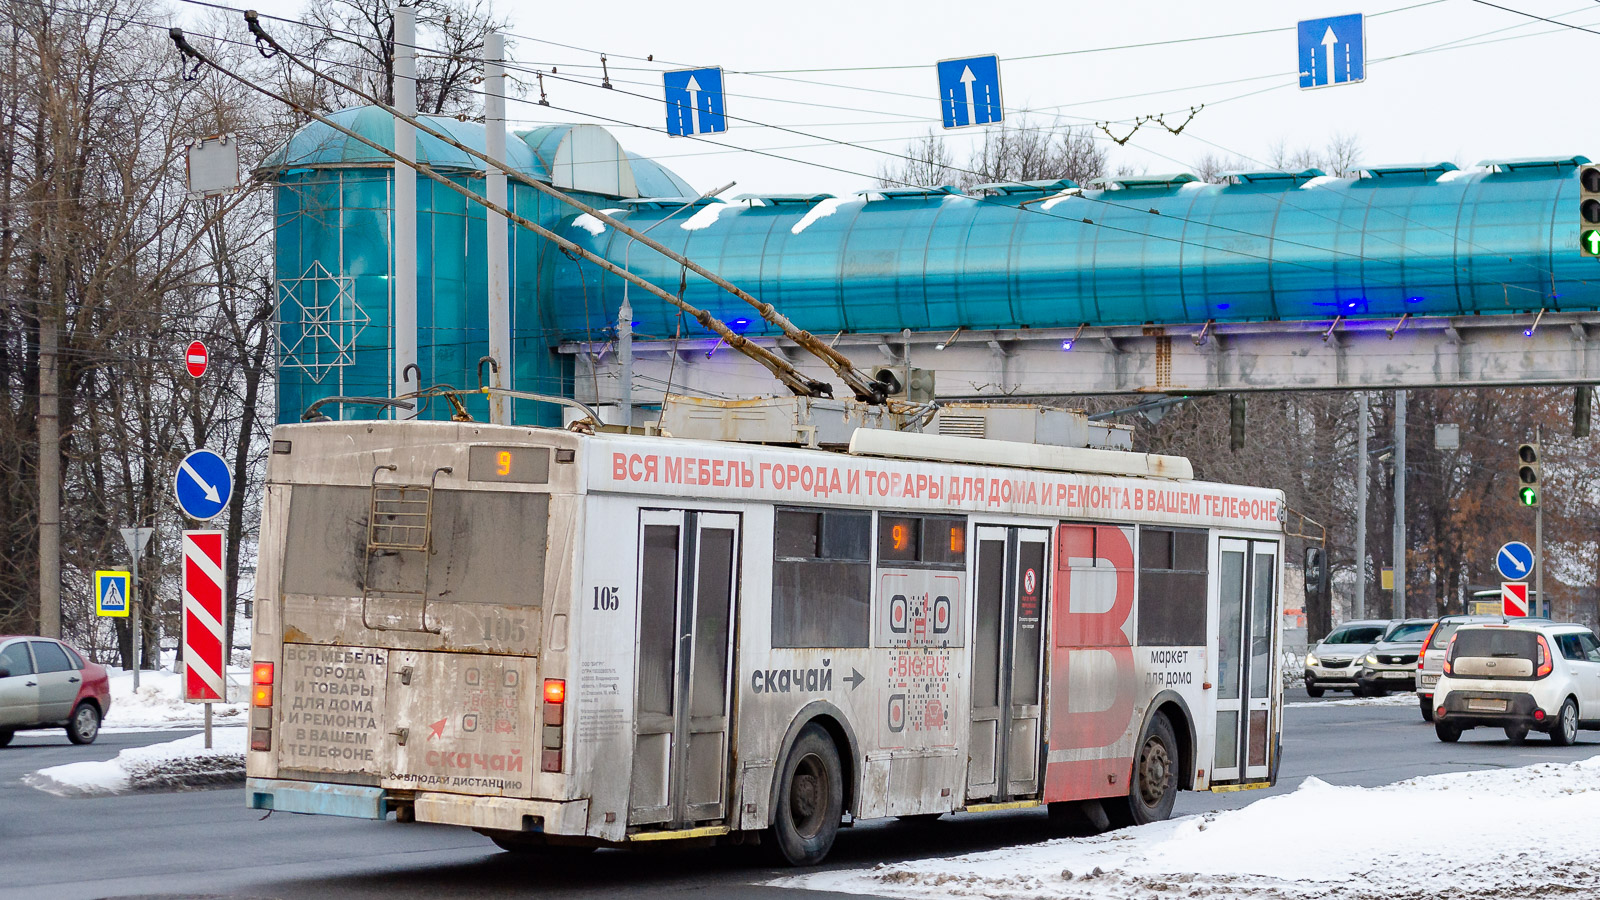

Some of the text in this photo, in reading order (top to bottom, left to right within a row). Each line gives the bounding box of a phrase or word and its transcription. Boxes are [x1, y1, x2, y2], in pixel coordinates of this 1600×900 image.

[496, 451, 512, 476] 9
[612, 452, 1277, 522] ВСЯ МЕБЕЛЬ ГОРОДА И ТОВАРЫ ДЛЯ ДОМА И РЕМОНТА В ВАШЕМ ТЕЛЕФОНЕ
[892, 525, 904, 549] 9
[592, 586, 619, 611] 105
[483, 617, 526, 642] 105
[287, 648, 386, 665] ВСЯ МЕБЕЛЬ
[1150, 649, 1188, 668] маркет
[304, 665, 366, 682] ГОРОДА
[751, 658, 832, 694] скачай
[1145, 670, 1192, 688] для дома
[295, 681, 374, 697] И ТОВАРЫ
[292, 696, 374, 713] ДЛЯ ДОМА
[288, 712, 377, 729] И РЕМОНТА
[296, 728, 368, 744] В ВАШЕМ
[289, 744, 374, 761] ТЕЛЕФОНЕ
[425, 749, 523, 772] скачай
[452, 776, 522, 790] ДИСТАНЦИЮ
